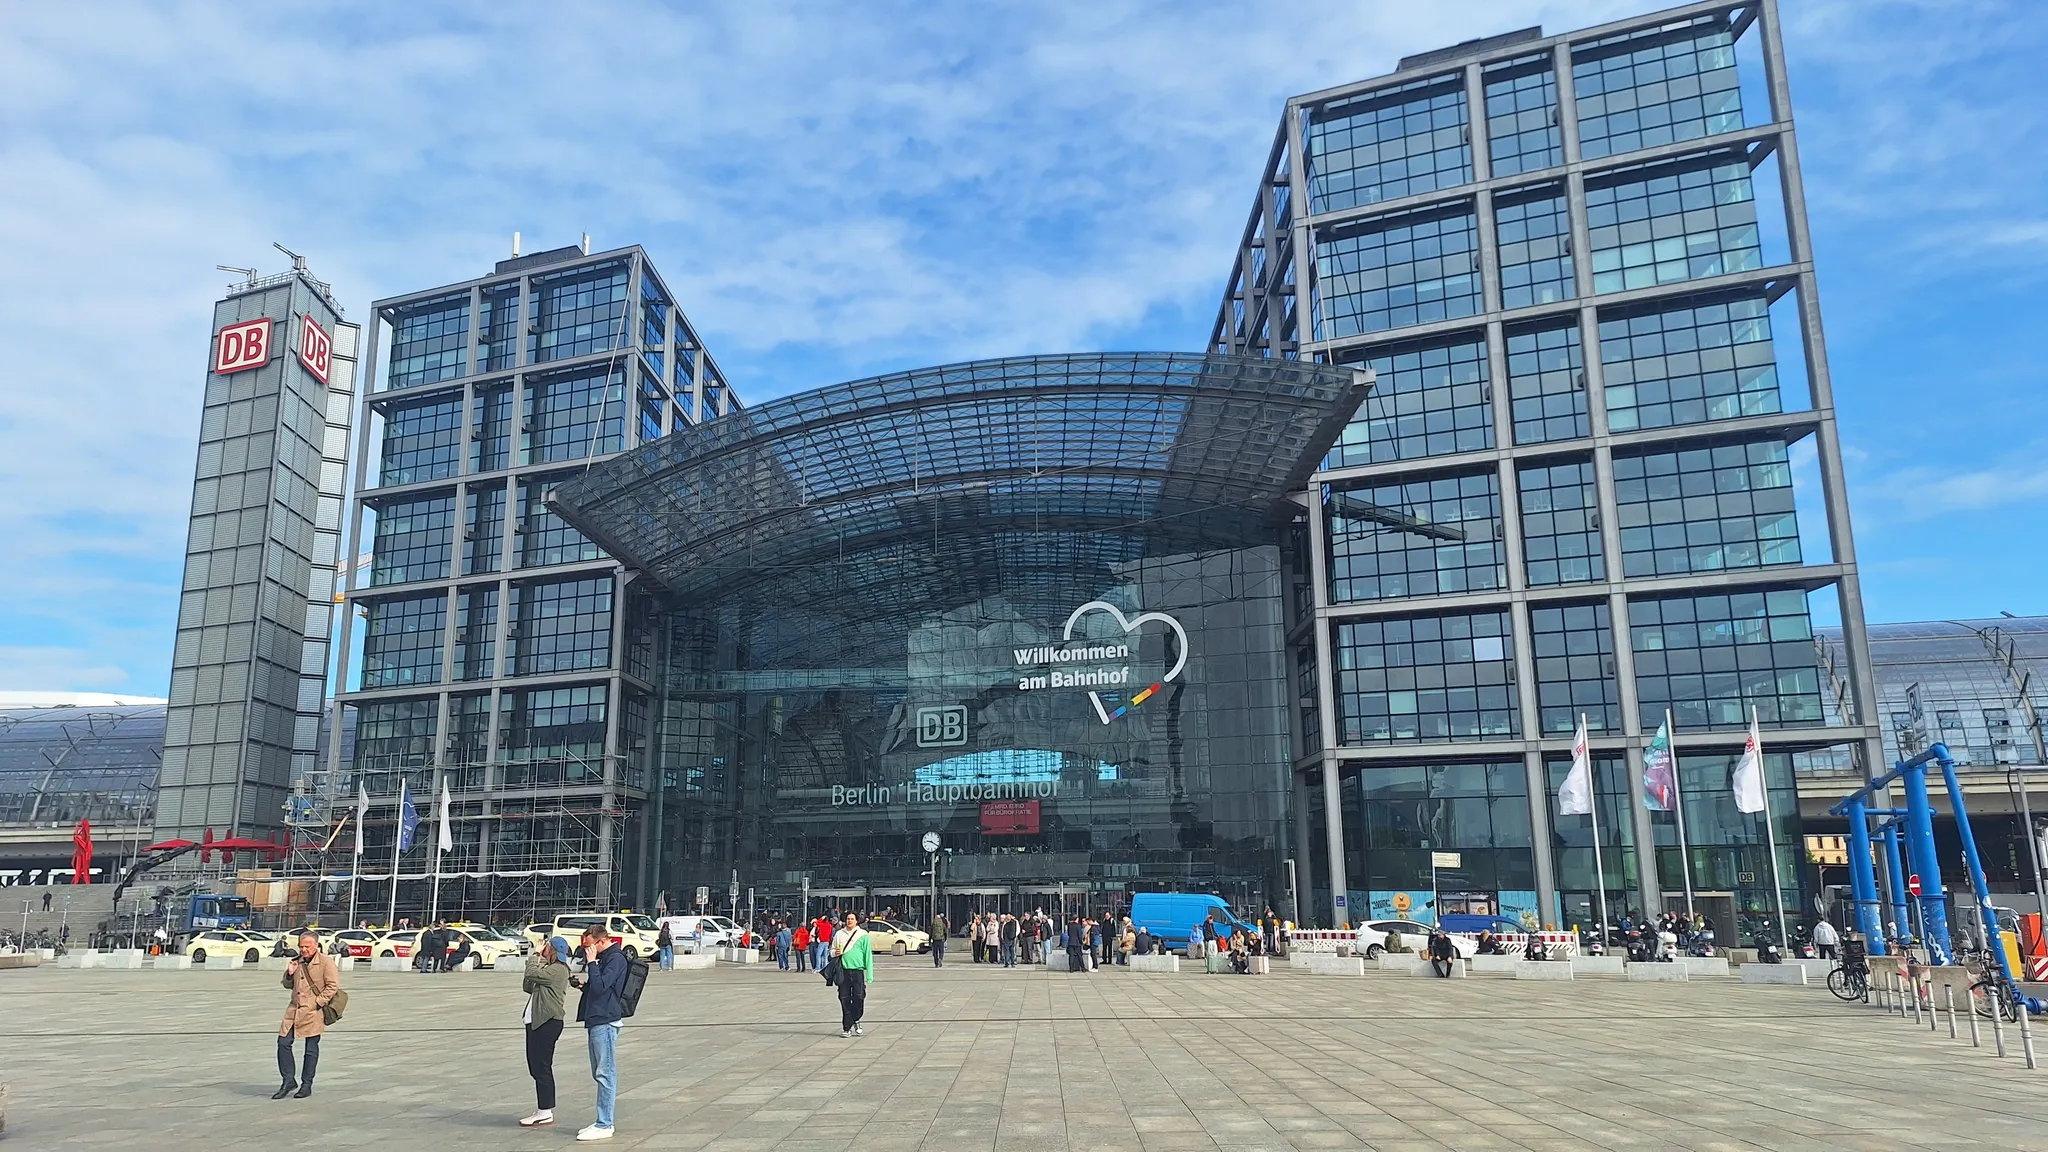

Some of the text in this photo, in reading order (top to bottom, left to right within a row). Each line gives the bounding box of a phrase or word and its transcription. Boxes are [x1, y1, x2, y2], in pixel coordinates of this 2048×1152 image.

[222, 327, 263, 366] DB
[304, 325, 327, 372] DB
[1014, 644, 1128, 665] Willkommen
[1019, 666, 1129, 690] am Bahnhof
[923, 712, 962, 741] DB
[831, 778, 1060, 806] Berlin Hauptbahnhof
[1740, 873, 1753, 881] DB
